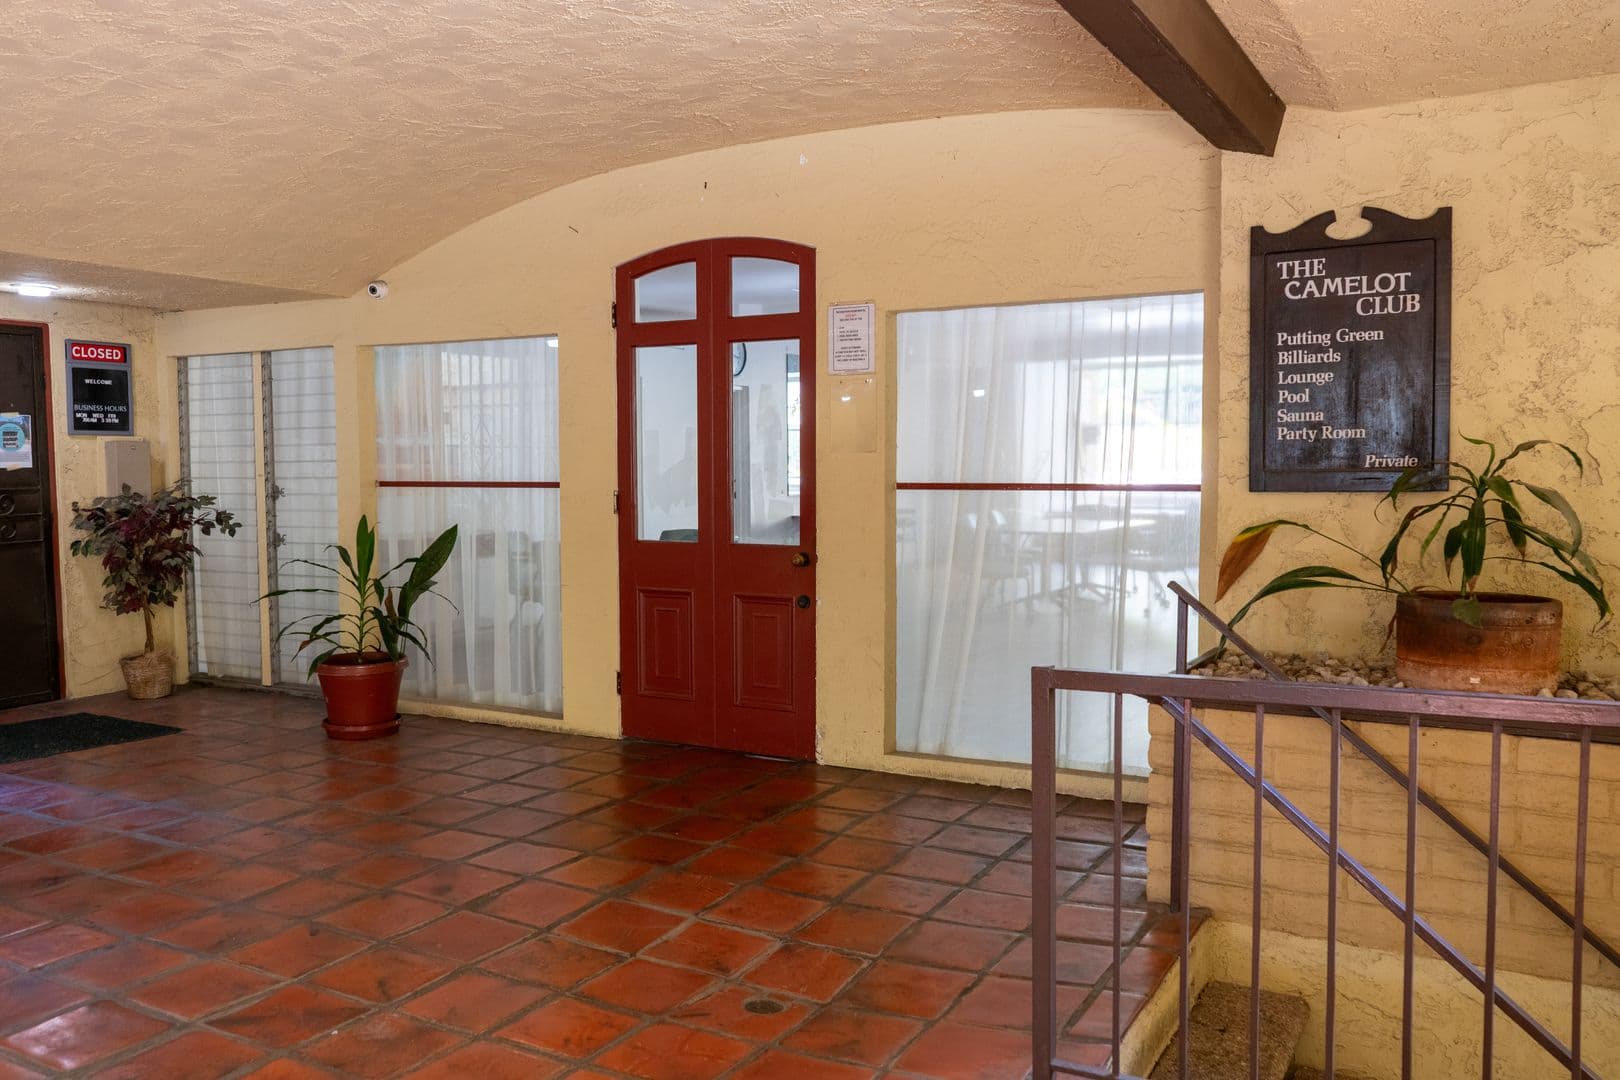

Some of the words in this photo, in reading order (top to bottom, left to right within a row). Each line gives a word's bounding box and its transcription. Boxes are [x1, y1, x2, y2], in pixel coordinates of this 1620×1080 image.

[1277, 258, 1326, 279] THE
[1284, 272, 1412, 300] CAMELOT
[1356, 293, 1421, 316] CLUB
[1276, 330, 1331, 347] Putting
[1336, 328, 1384, 343] Green
[72, 346, 121, 360] CLOSED
[1277, 348, 1341, 365] Billiards
[1278, 371, 1334, 386] Lounge
[1278, 388, 1310, 404] Pool
[74, 404, 103, 412] BUSINESS
[1277, 408, 1324, 423] Sauna
[1276, 426, 1317, 442] Party
[1322, 425, 1366, 439] Room
[1364, 454, 1418, 468] Private
